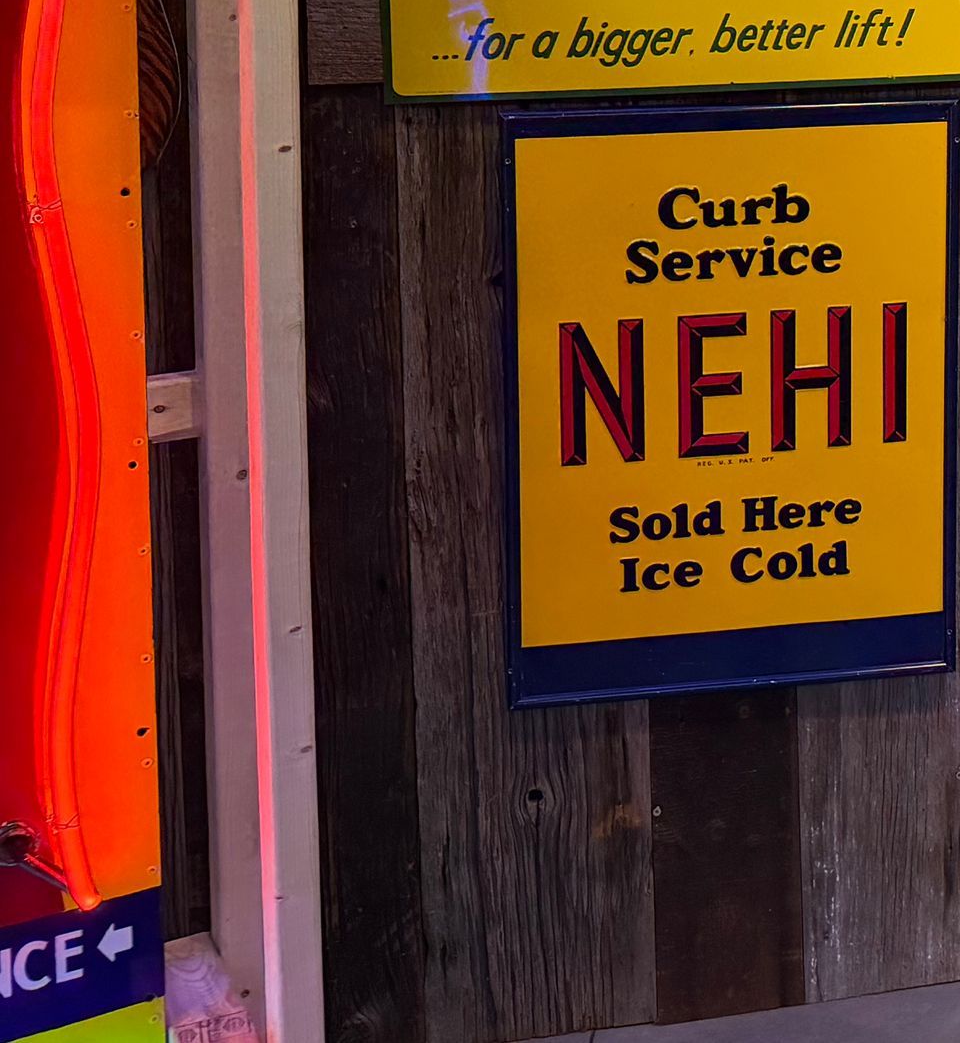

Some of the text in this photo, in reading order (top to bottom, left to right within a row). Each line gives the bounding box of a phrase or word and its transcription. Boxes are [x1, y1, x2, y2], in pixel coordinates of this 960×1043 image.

[532, 32, 560, 58] a
[566, 19, 696, 68] bigger,
[709, 13, 825, 53] better
[833, 8, 916, 48] lift!
[657, 183, 810, 230] Curb
[625, 236, 843, 284] Service
[558, 301, 907, 467] NEHI
[609, 495, 862, 544] Sold Here
[620, 540, 850, 593] Ice Cold
